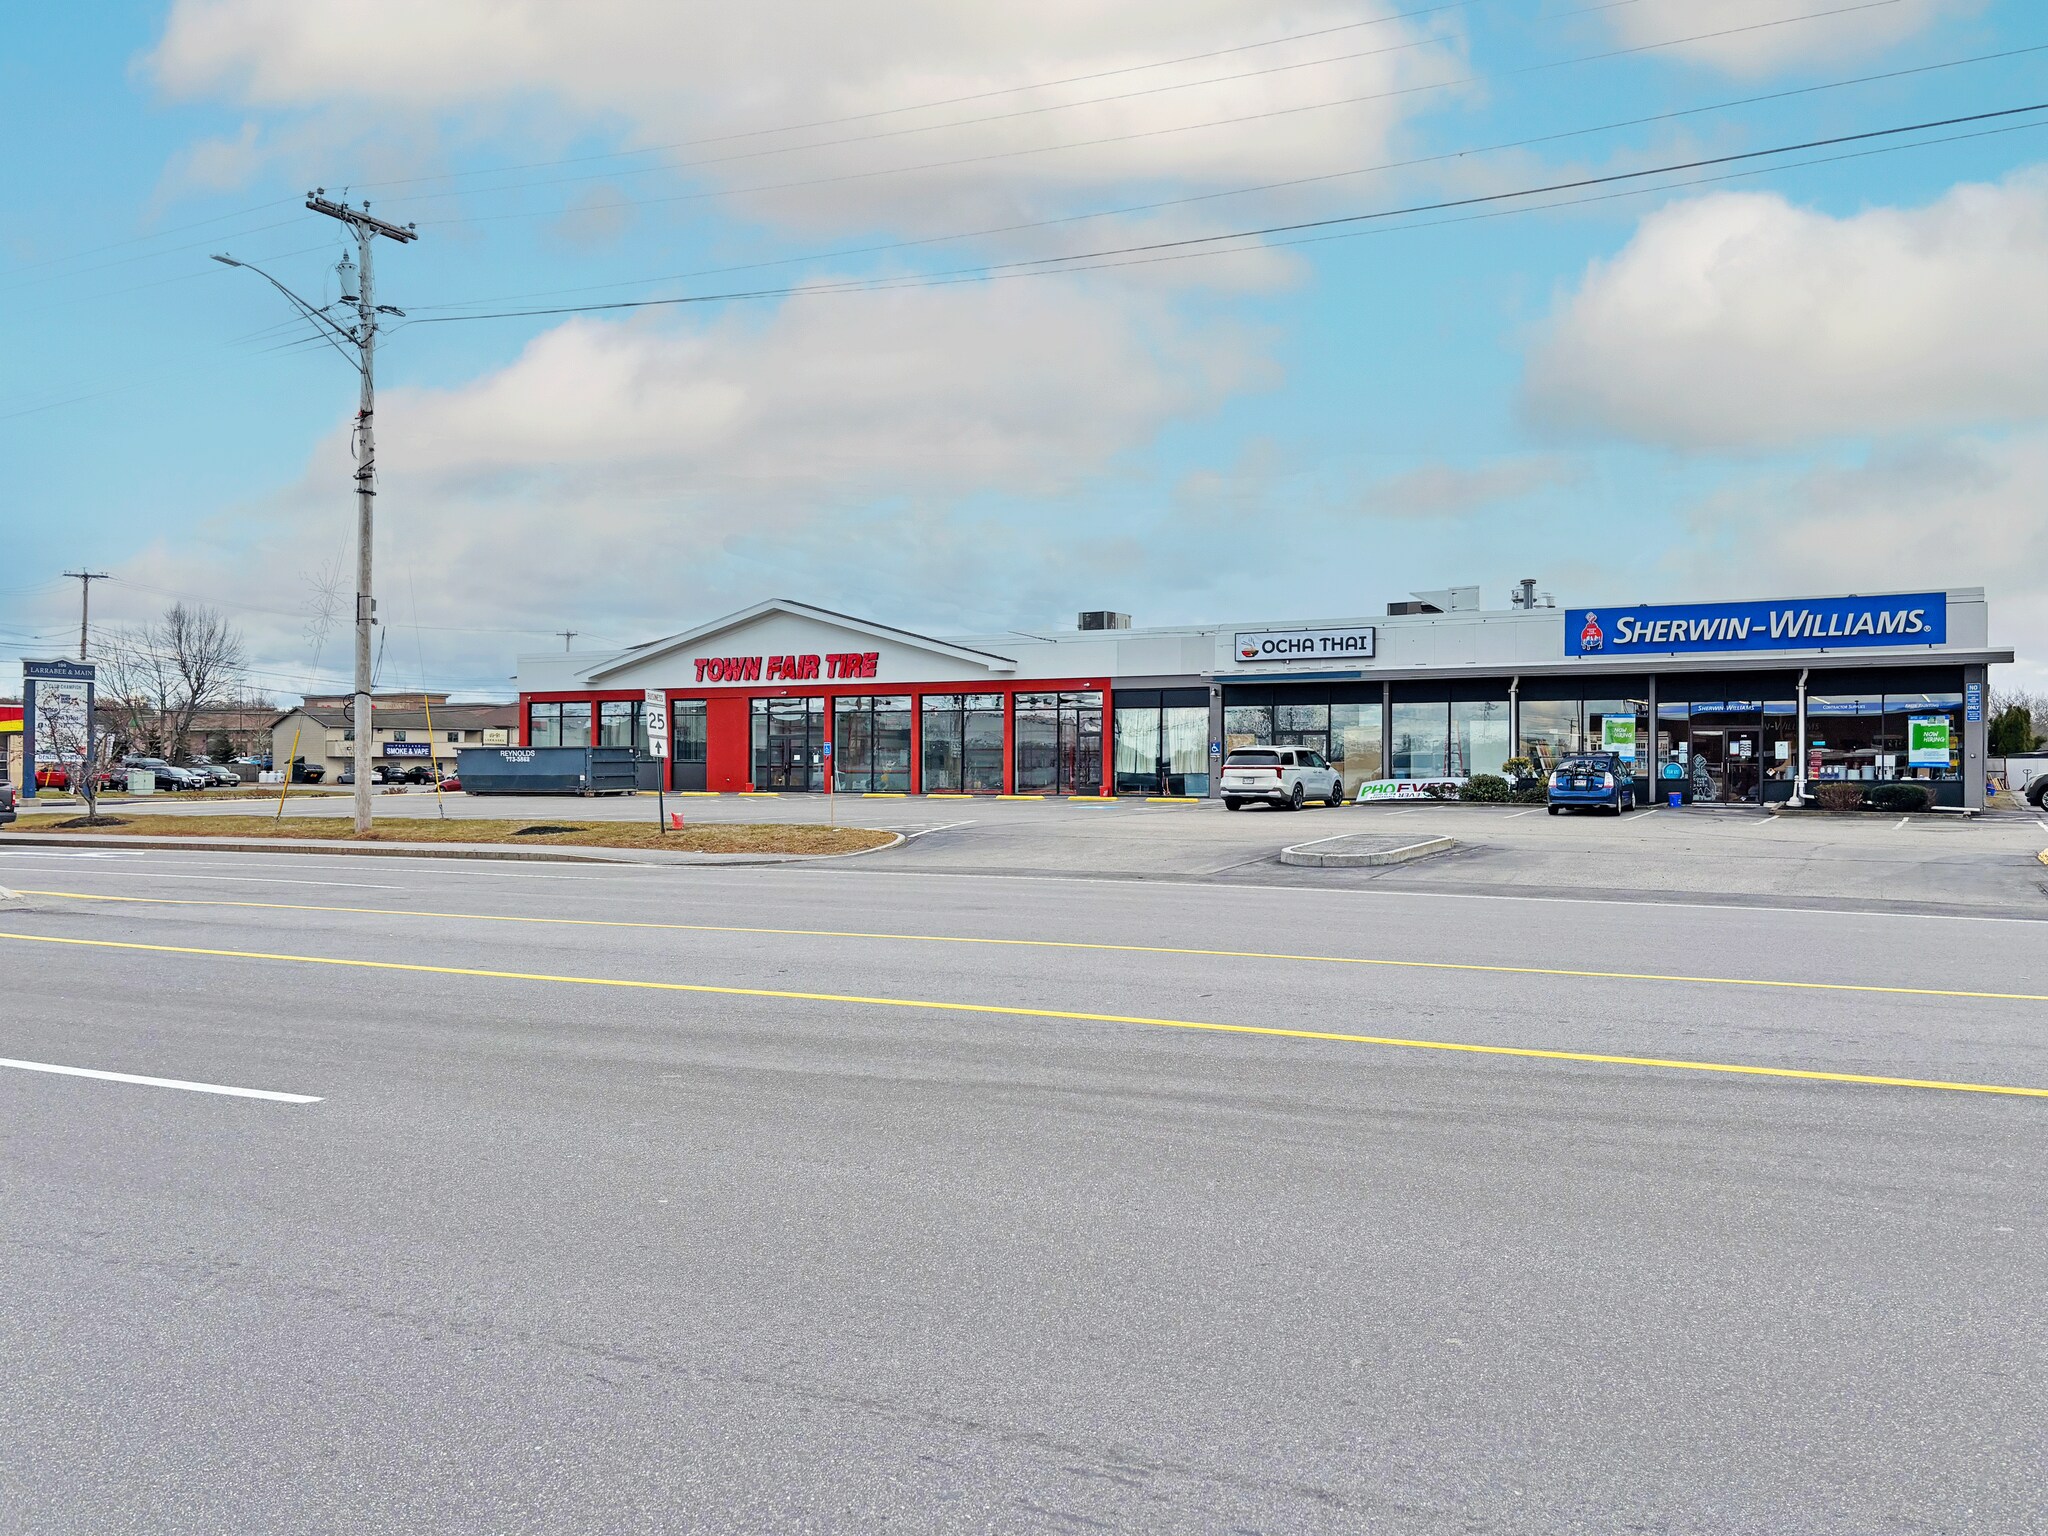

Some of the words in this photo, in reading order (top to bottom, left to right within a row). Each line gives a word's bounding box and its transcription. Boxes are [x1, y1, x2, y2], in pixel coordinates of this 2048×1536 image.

[1613, 609, 1925, 644] SHERWIN-WILLIAMS
[1262, 638, 1315, 654] OCHA
[1319, 635, 1367, 652] THAI
[30, 667, 67, 675] LARRABEE
[693, 656, 763, 683] TOWN
[766, 654, 821, 681] FAIR
[825, 652, 880, 679] TIRE
[648, 712, 665, 730] 25
[386, 747, 408, 755] SMOKE
